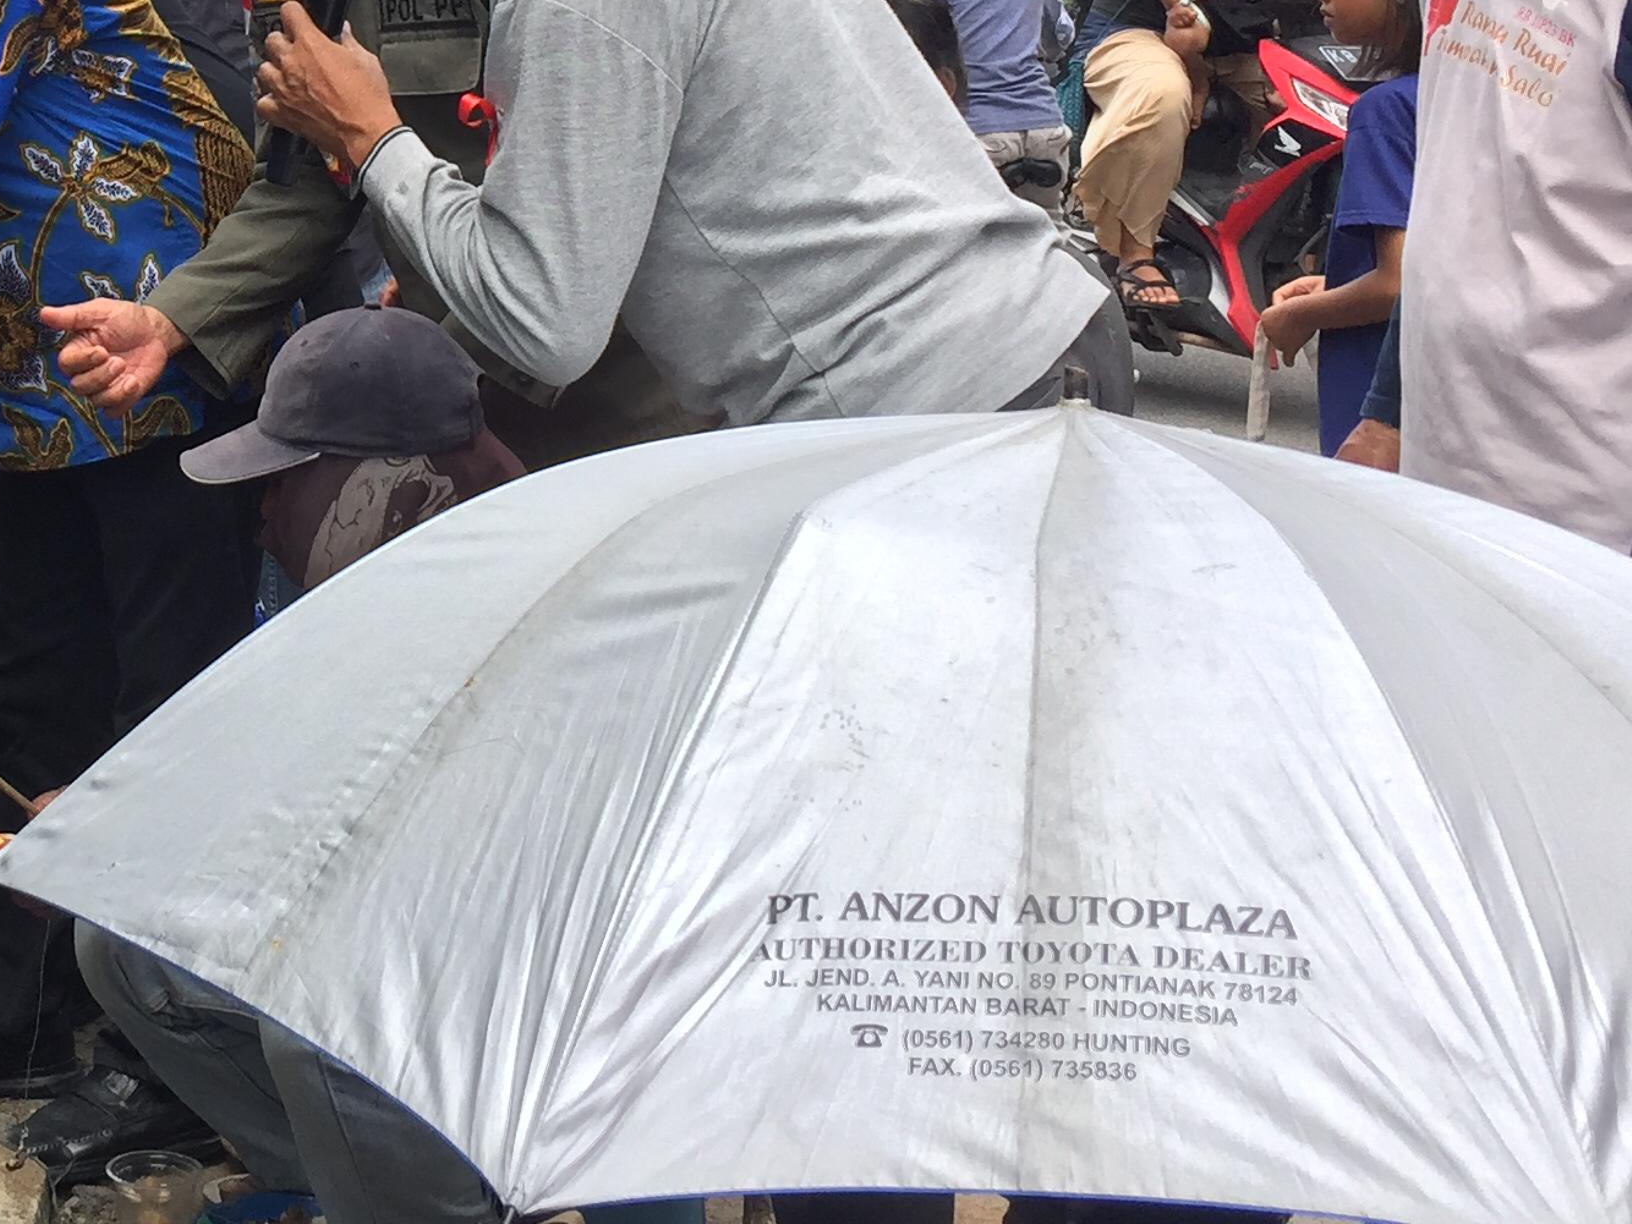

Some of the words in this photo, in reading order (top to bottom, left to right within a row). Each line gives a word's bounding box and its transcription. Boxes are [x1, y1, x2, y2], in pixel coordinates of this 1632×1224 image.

[767, 892, 824, 924] PT.
[838, 890, 1001, 925] ANZON
[1014, 893, 1299, 940] AUTOPLAZA
[998, 940, 1141, 968] TOYOTA
[1153, 945, 1312, 981] DEALER
[764, 969, 798, 988] JL.
[804, 967, 875, 988] JEND.
[881, 968, 906, 988] A.
[914, 969, 970, 990] YANI
[977, 971, 1020, 991] NO.
[1029, 972, 1057, 991] 89
[1065, 972, 1216, 1000] PONTIANAK
[1223, 982, 1299, 1007] 78124
[816, 993, 977, 1016] KALIMANTAN
[986, 996, 1071, 1018] BARAT
[1092, 999, 1239, 1027] INDONESIA
[902, 1029, 973, 1054] (0561)
[981, 1030, 1065, 1051] 734280
[1072, 1032, 1191, 1058] HUNTING
[907, 1057, 962, 1077] FAX.
[970, 1058, 1044, 1082] (0561)
[1052, 1060, 1138, 1081] 735836
